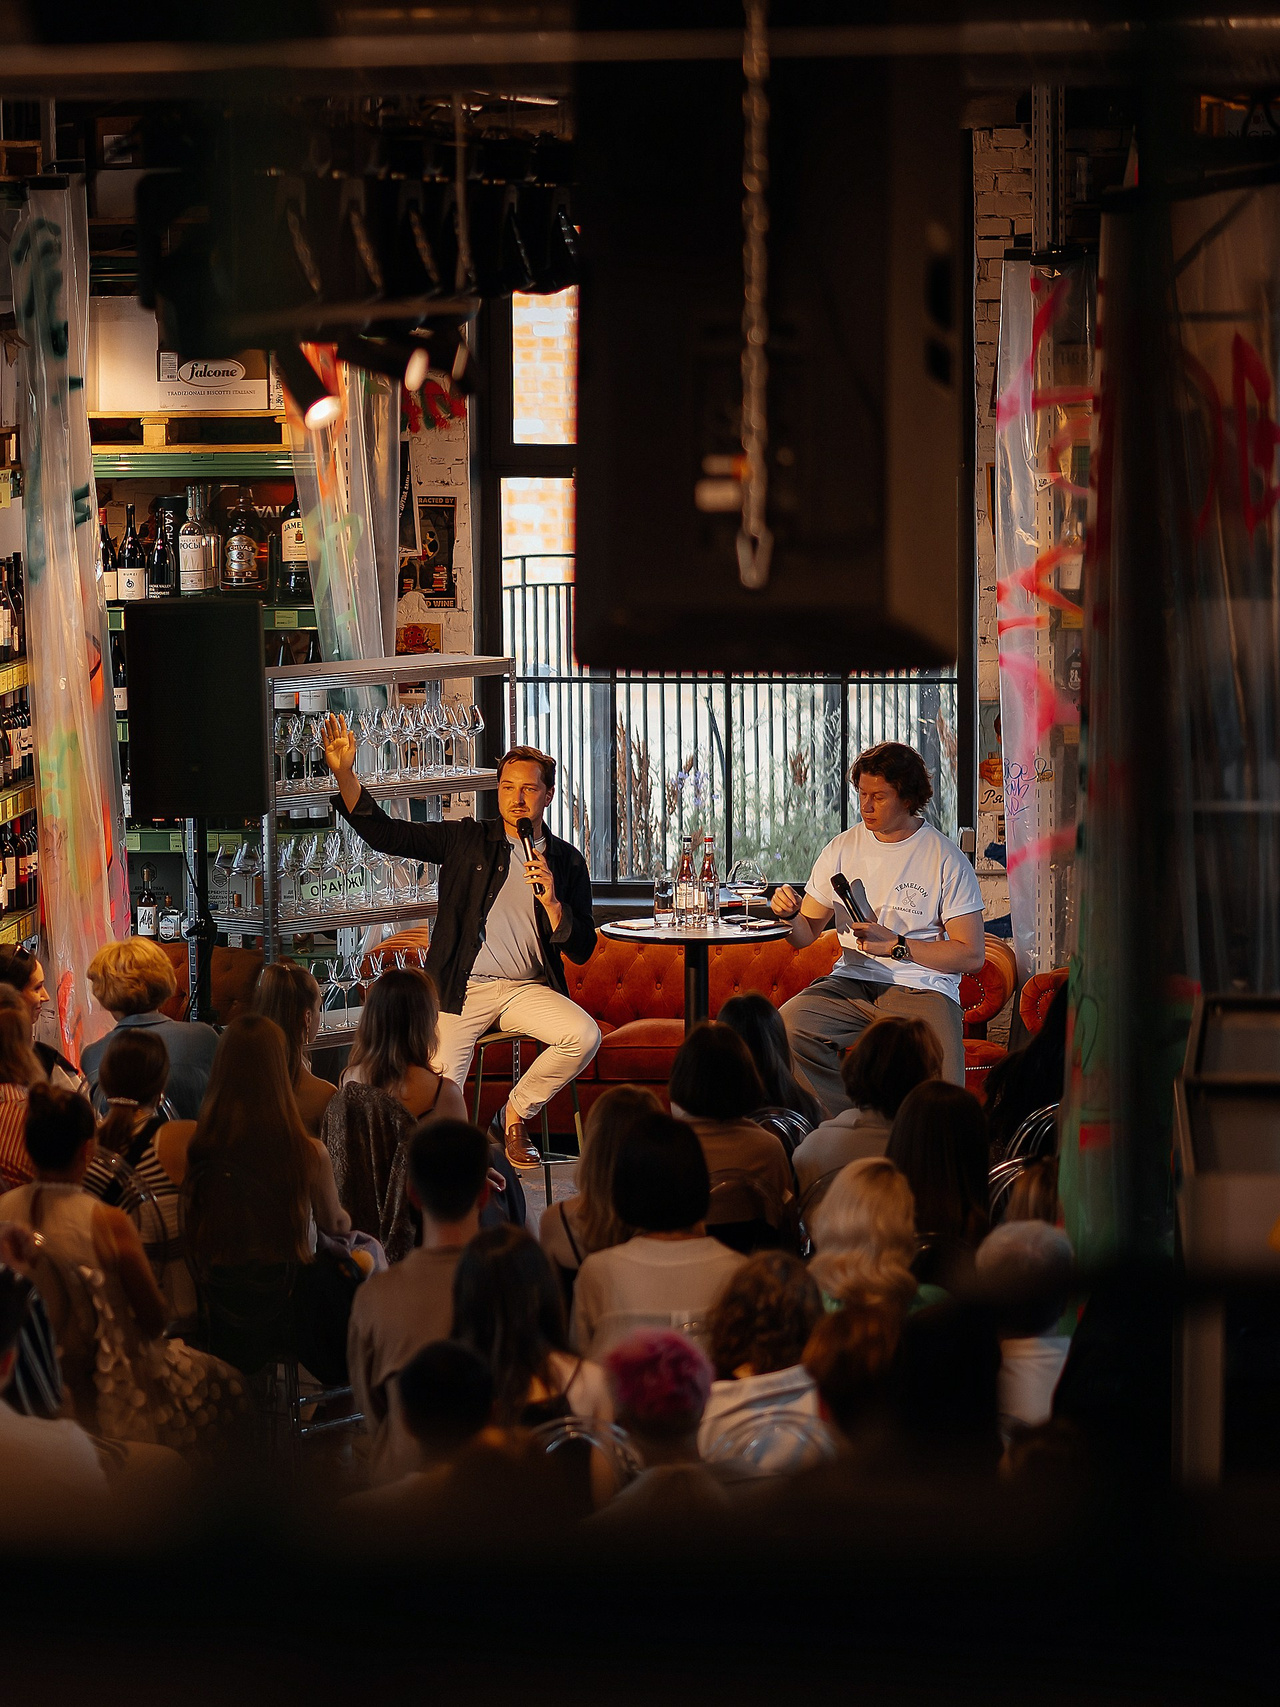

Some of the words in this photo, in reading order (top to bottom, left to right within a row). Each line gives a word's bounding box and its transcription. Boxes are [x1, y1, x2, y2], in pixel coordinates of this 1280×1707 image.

[187, 362, 238, 381] falcone
[418, 496, 443, 504] RACTED
[445, 496, 454, 504] BY
[229, 544, 253, 552] CHIVAS
[894, 882, 929, 898] TEMELION
